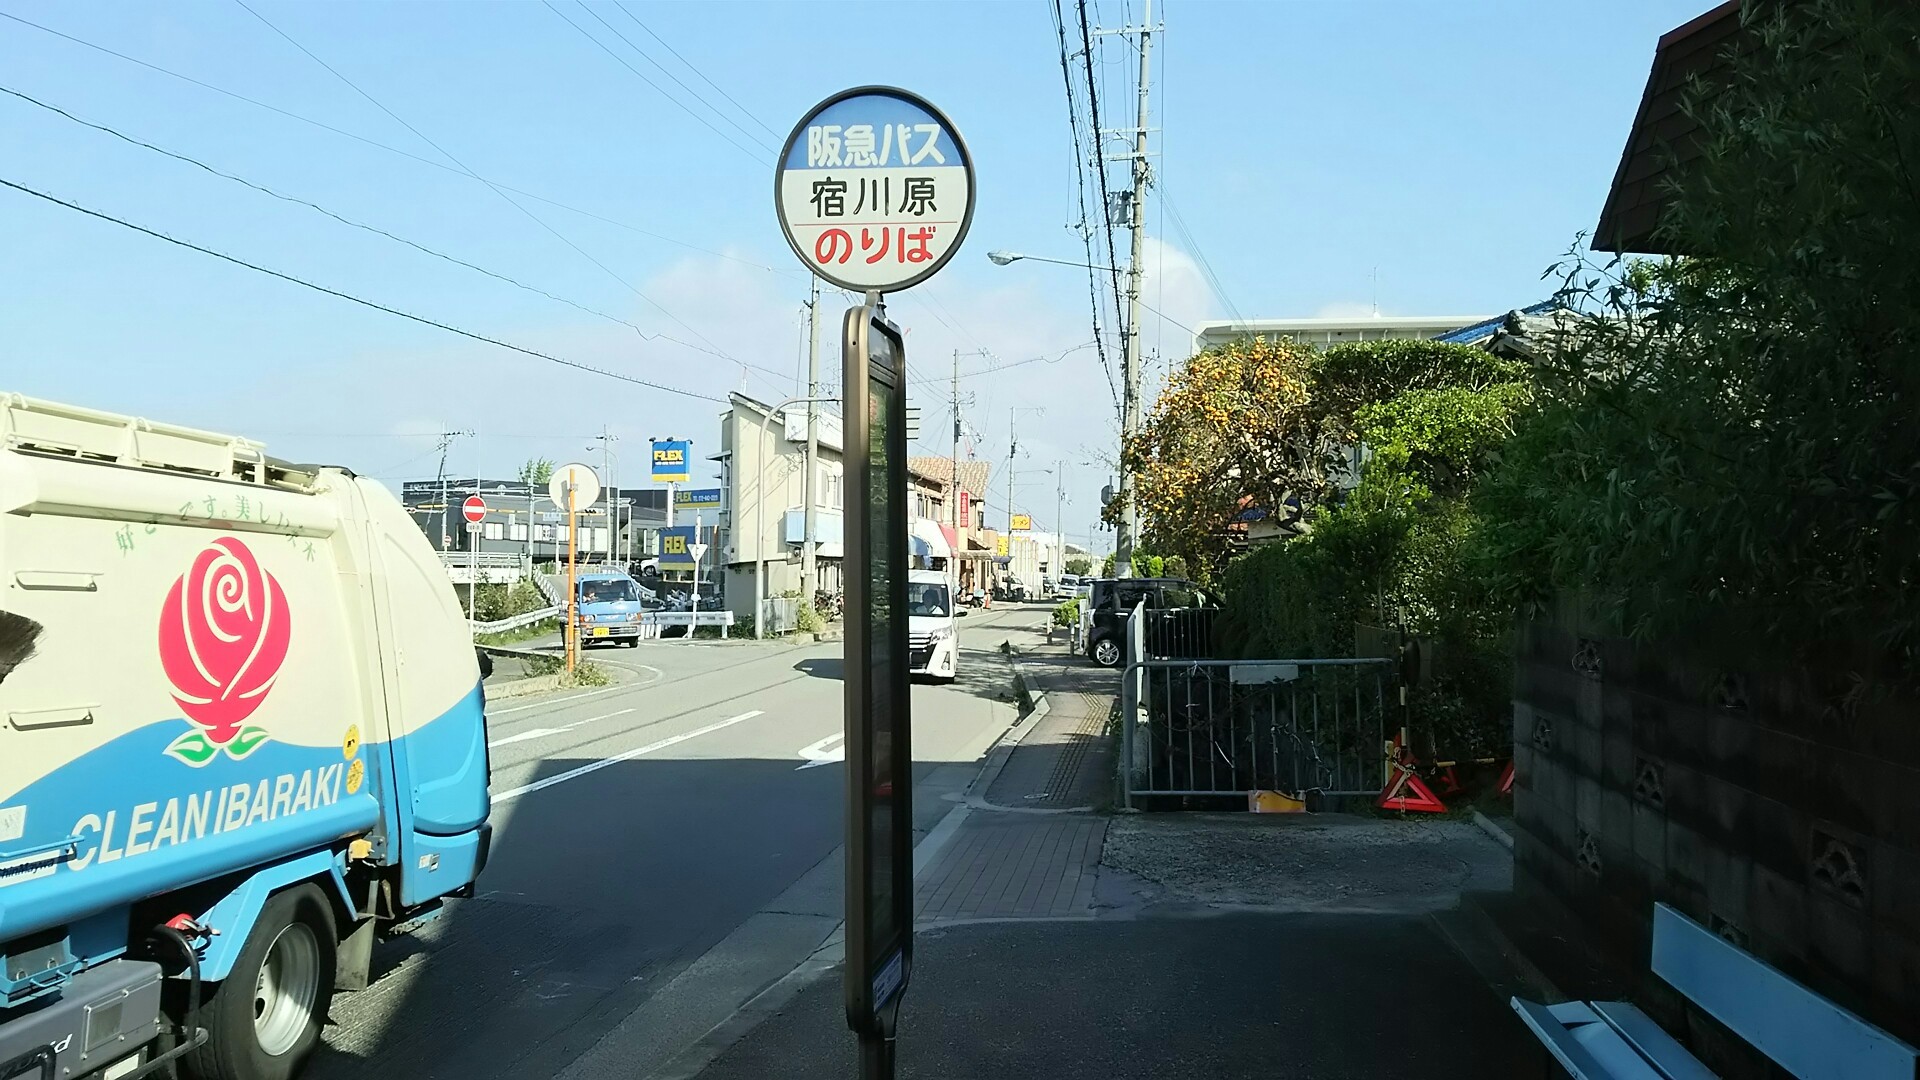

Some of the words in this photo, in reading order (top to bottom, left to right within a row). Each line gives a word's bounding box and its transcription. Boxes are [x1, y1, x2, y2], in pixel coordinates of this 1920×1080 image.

[807, 123, 946, 168] 阪急バス
[810, 176, 938, 218] 宿川原
[814, 226, 937, 265] のりば
[654, 450, 684, 461] FLEX
[676, 491, 692, 502] FLEX
[664, 536, 687, 554] FLEX
[67, 790, 211, 871] CLEAN
[213, 763, 344, 833] IBARAKI
